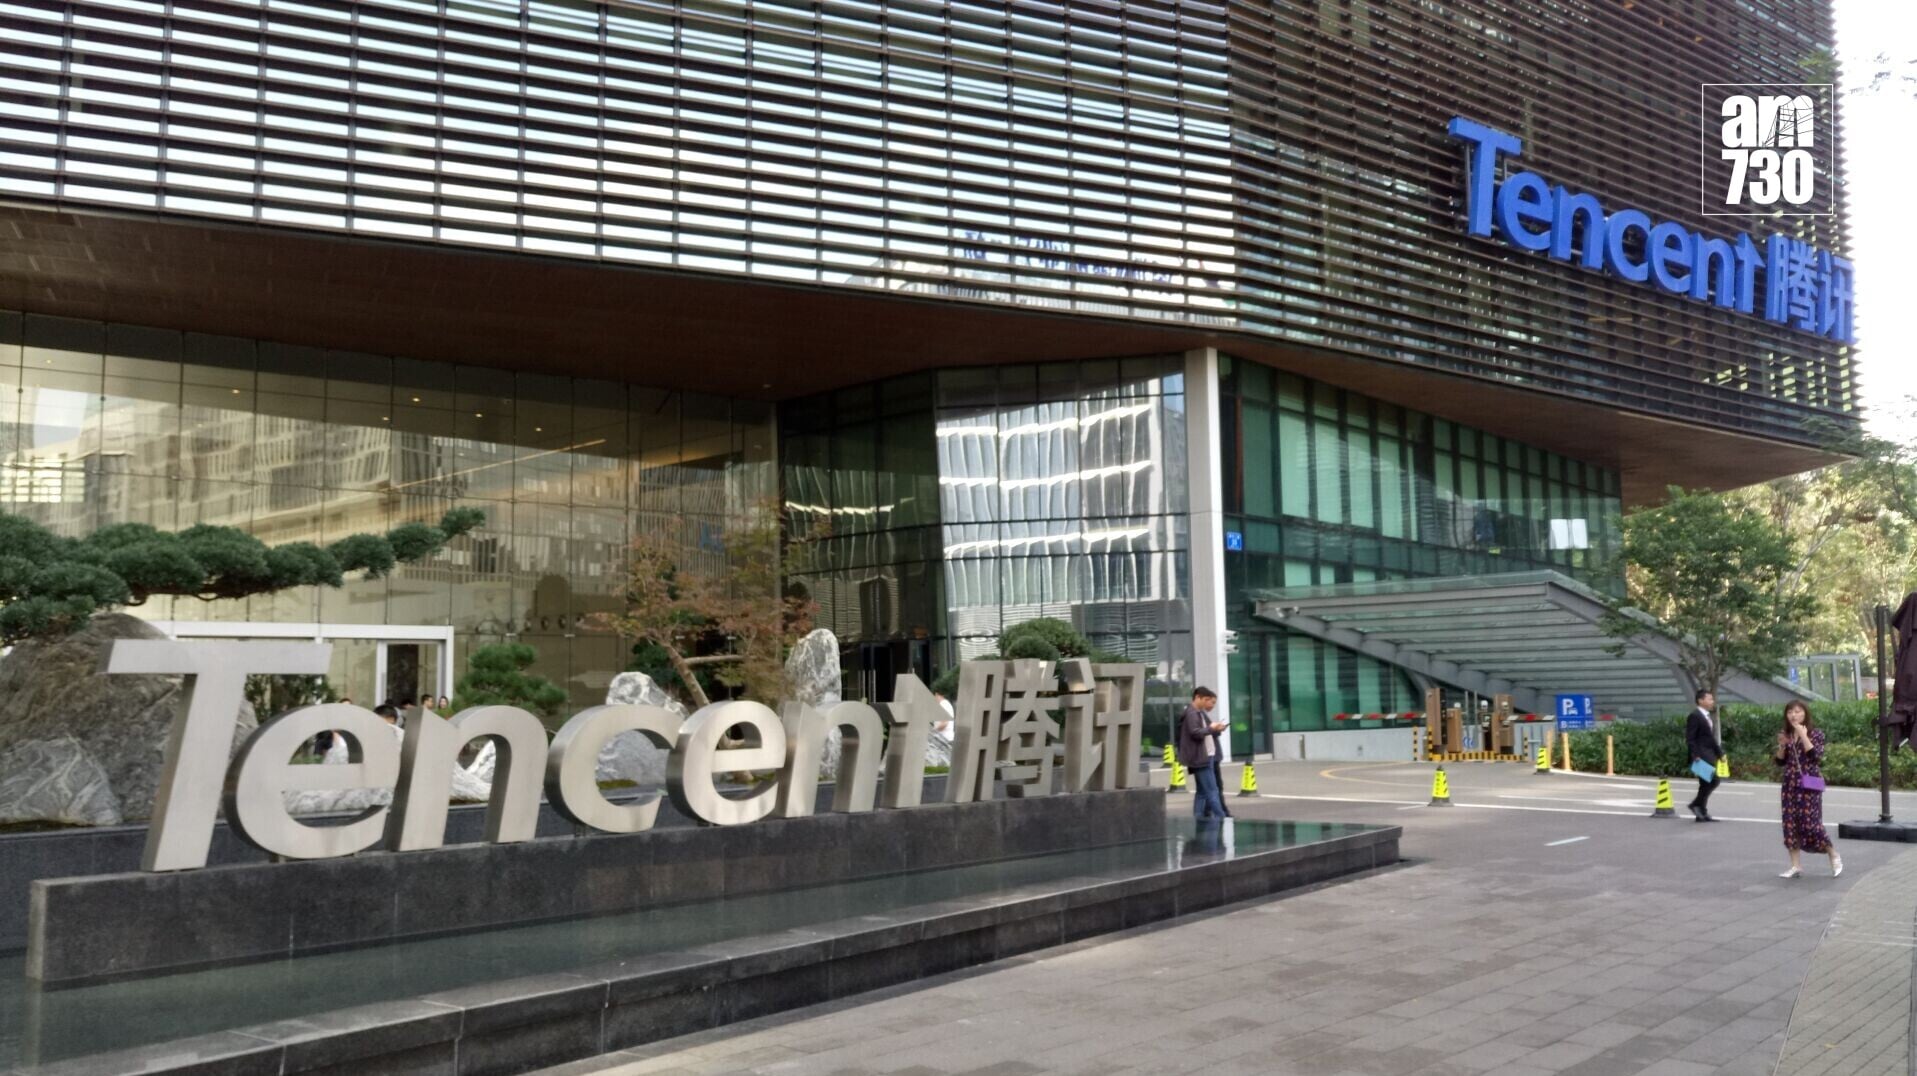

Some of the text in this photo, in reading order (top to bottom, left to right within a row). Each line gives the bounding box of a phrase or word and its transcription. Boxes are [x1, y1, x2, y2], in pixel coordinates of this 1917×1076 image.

[1448, 115, 1856, 344] Tencent 腾讯
[106, 638, 1146, 872] Tencent 腾讯
[1562, 698, 1574, 715] P
